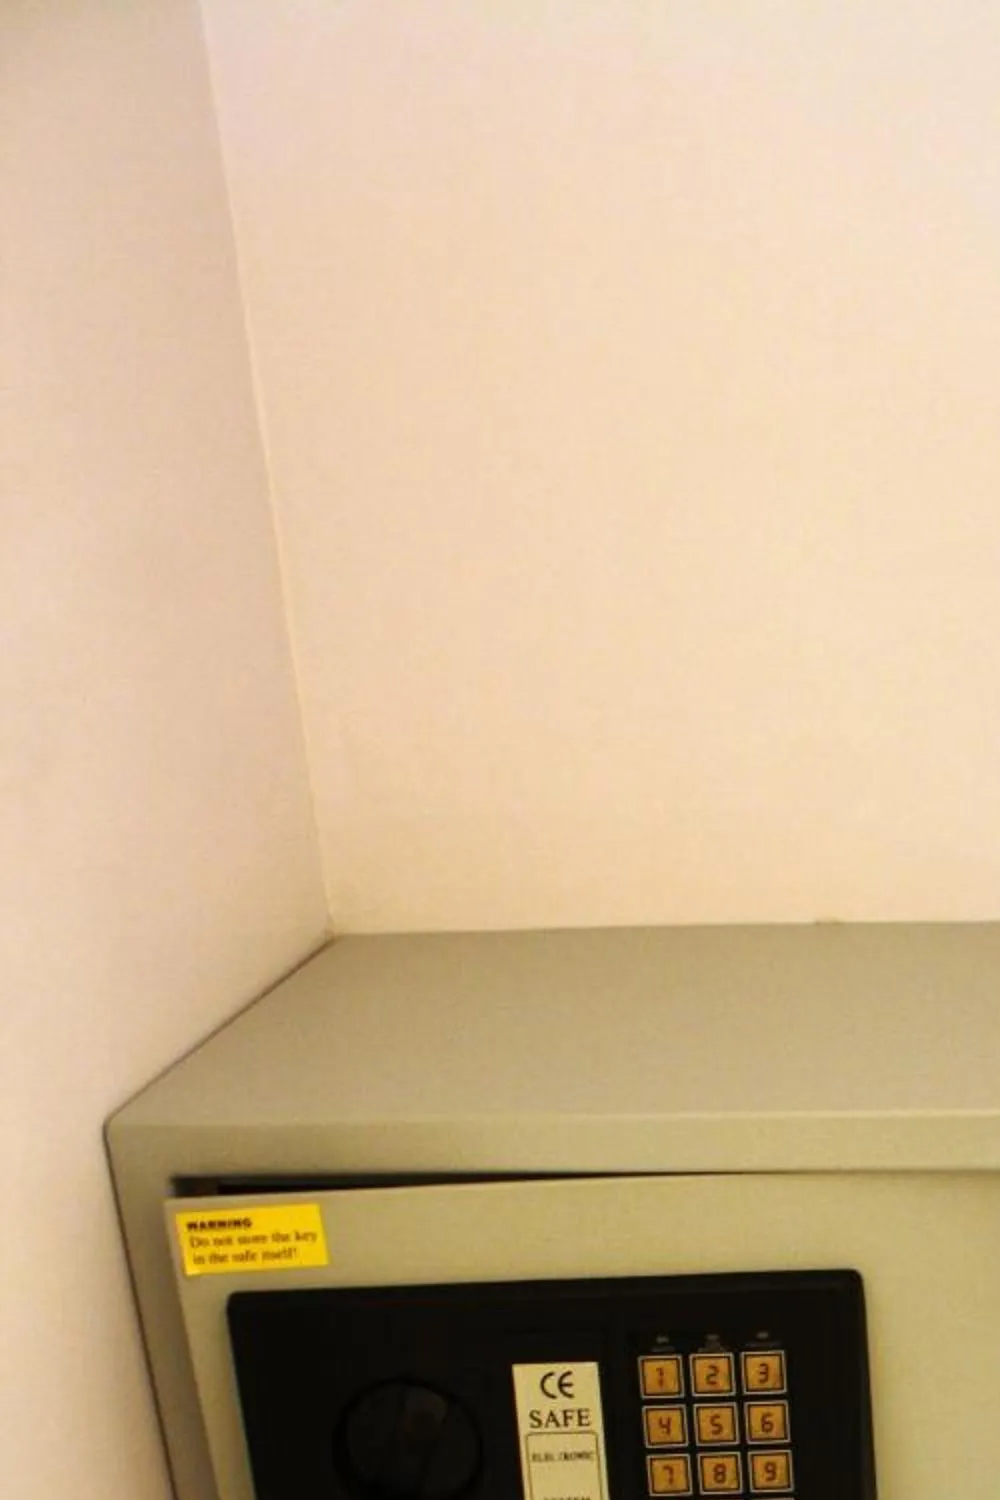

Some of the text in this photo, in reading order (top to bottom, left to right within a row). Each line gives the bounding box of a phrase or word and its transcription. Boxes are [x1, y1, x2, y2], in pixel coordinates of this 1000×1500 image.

[186, 1217, 253, 1230] WARNING
[190, 1236, 210, 1248] Do
[213, 1235, 233, 1246] not
[271, 1231, 290, 1243] the
[294, 1230, 317, 1243] key
[209, 1252, 228, 1264] the
[231, 1249, 257, 1263] safe
[655, 1362, 770, 1388] 1 2 3
[529, 1408, 592, 1429] SAFE
[658, 1411, 774, 1437] 4 5 6
[663, 1461, 778, 1485] 7 8 9
